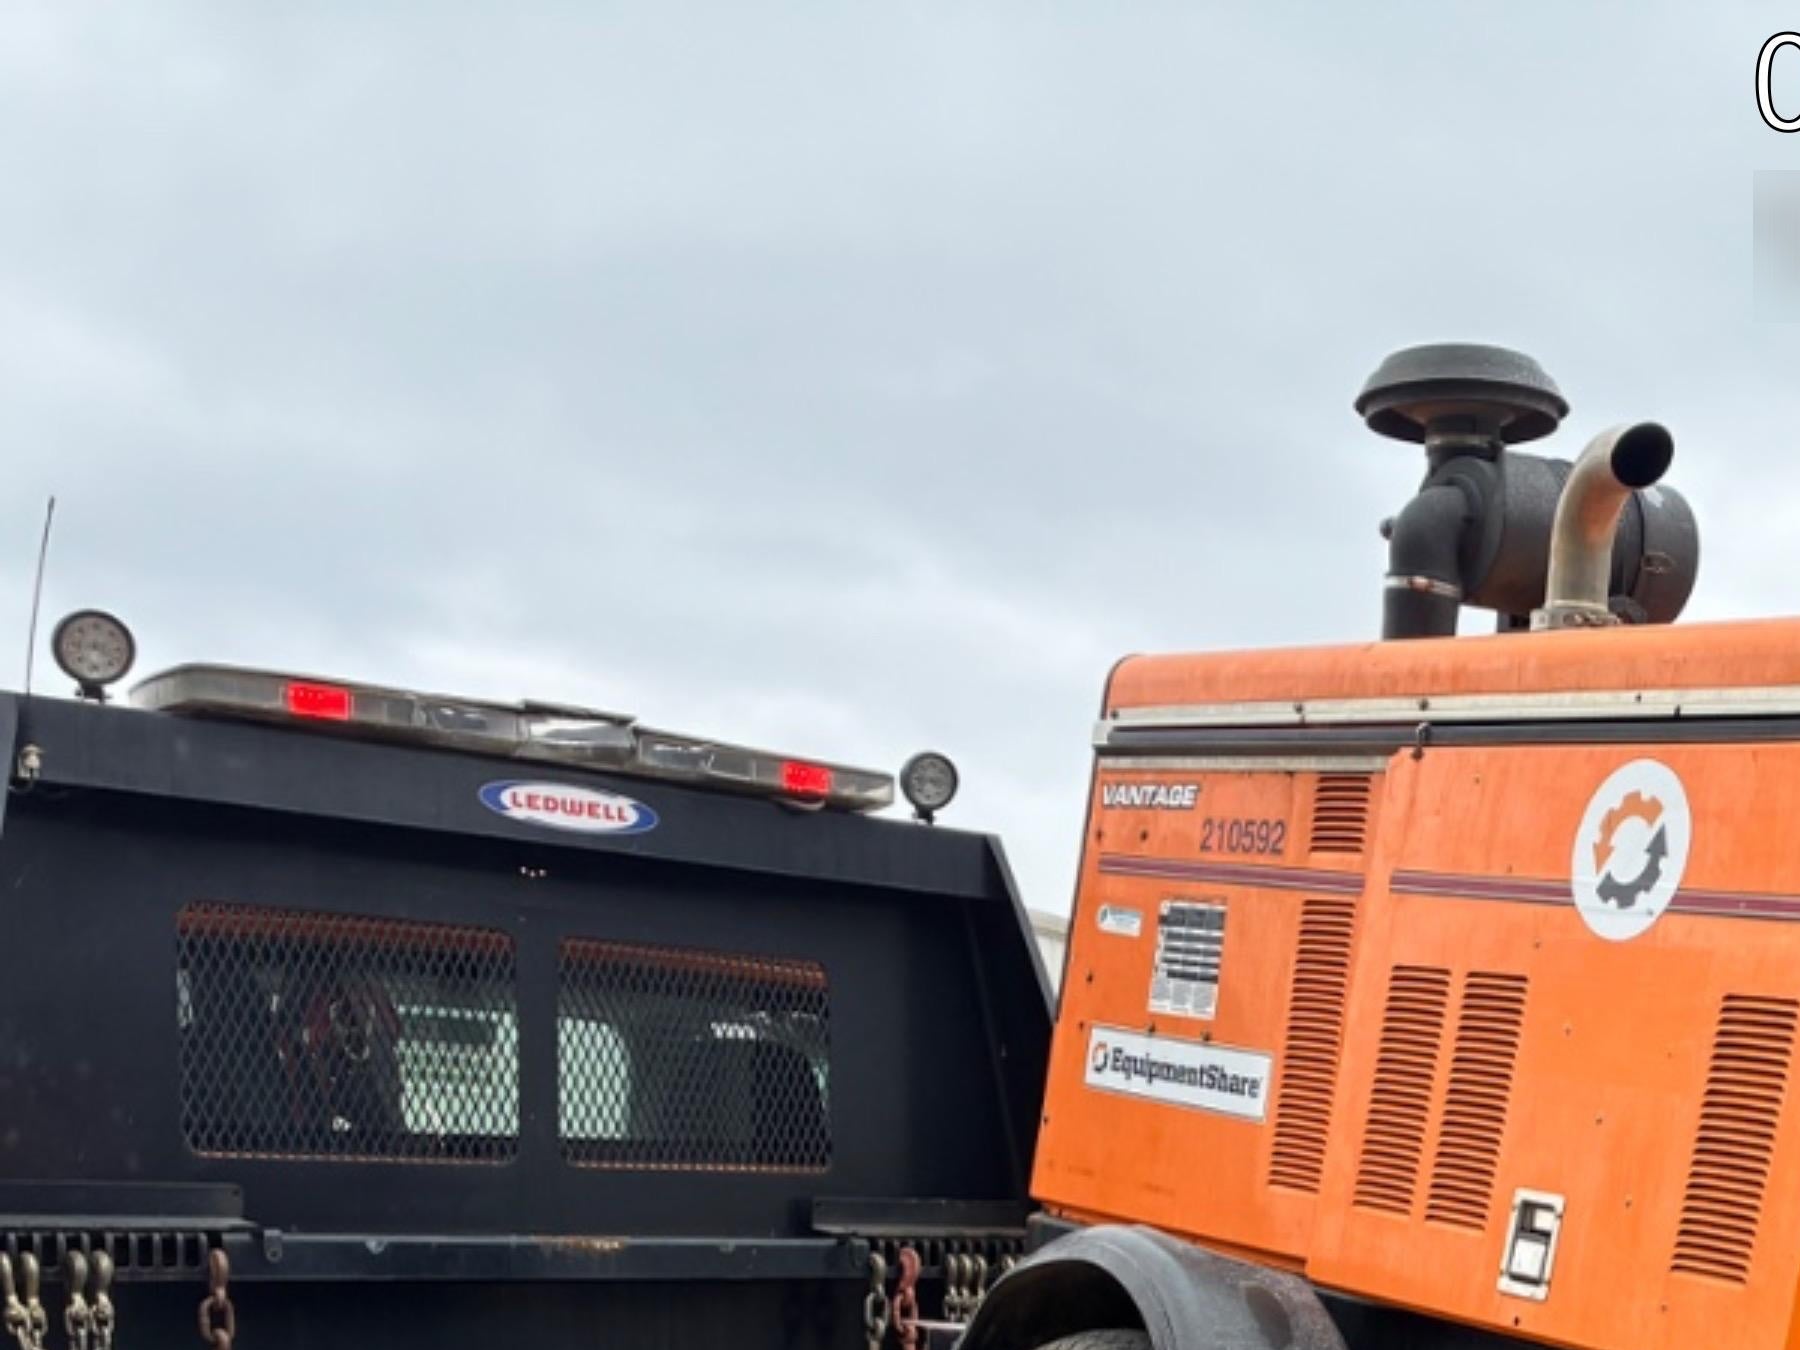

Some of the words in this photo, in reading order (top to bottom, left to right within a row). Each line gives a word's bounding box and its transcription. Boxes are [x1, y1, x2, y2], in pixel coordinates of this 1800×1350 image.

[511, 791, 628, 822] LEDWELL
[1103, 784, 1198, 807] VANTAGE
[1200, 818, 1287, 854] 210592
[1112, 1046, 1261, 1099] EquipmentShare
